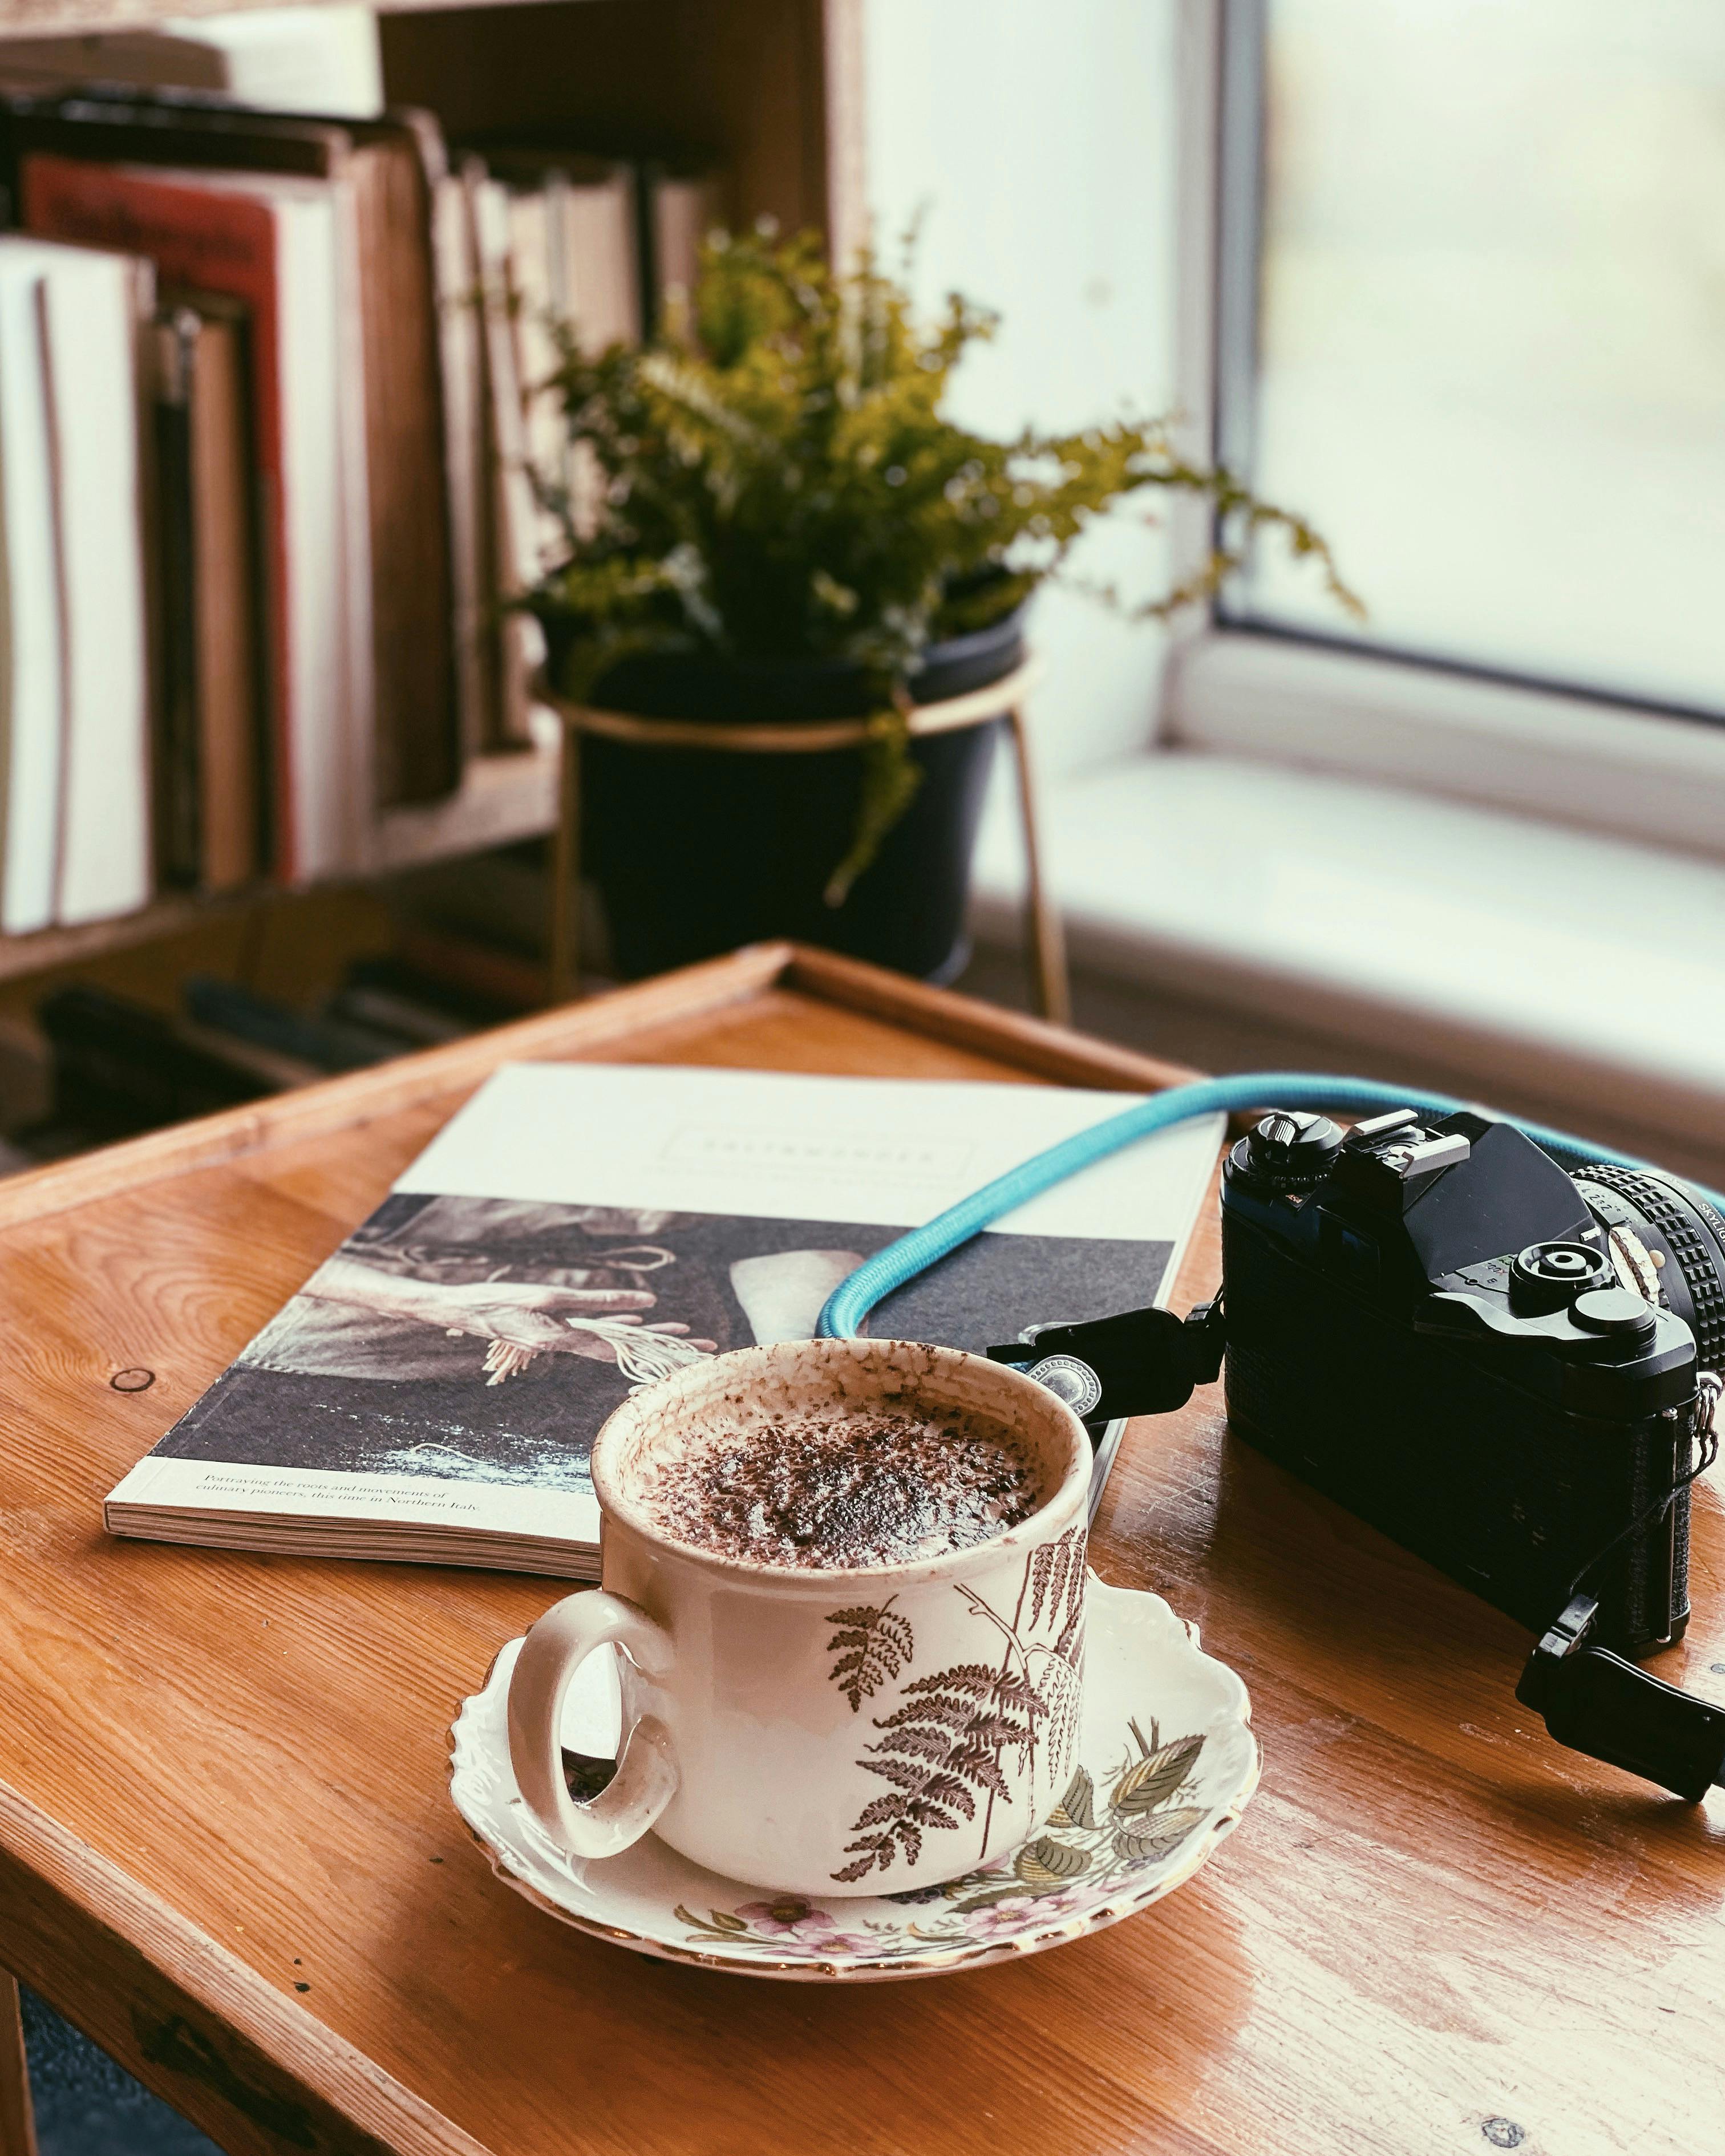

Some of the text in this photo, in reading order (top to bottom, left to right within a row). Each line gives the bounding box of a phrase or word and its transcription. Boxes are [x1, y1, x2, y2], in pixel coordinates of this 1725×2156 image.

[1698, 1203, 1725, 1243] SKYLIG
[195, 1484, 249, 1494] culinary
[249, 1489, 306, 1498] pioneers,
[386, 1497, 446, 1507] Northern
[450, 1502, 480, 1511] Italy.
[204, 1475, 270, 1486] Portraying
[358, 1488, 430, 1497] movements
